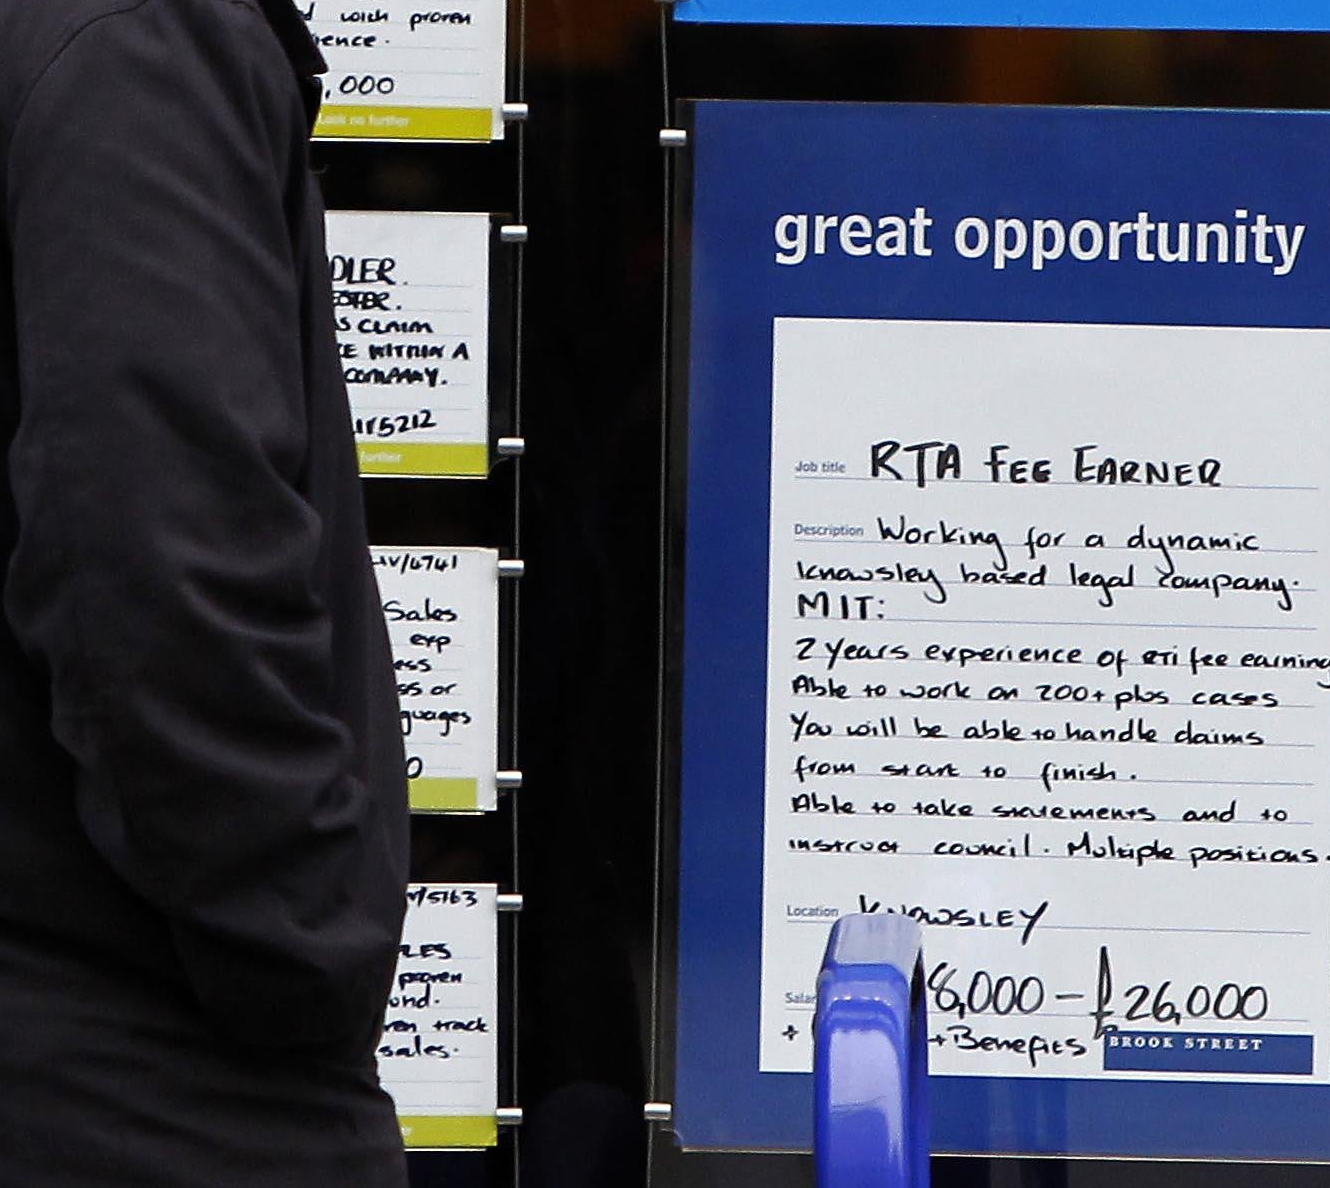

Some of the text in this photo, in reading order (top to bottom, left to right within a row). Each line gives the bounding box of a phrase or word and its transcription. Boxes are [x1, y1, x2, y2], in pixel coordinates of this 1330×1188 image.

[775, 208, 1305, 275] great opportunity
[795, 460, 845, 478] Job title
[872, 441, 960, 488] RTA
[1074, 446, 1220, 487] EARNER
[795, 524, 863, 542] Description
[877, 516, 1259, 574] Working for a dynamic
[961, 560, 1046, 585] based
[1070, 563, 1133, 607] legal
[786, 904, 840, 921] Location
[1110, 1036, 1262, 1050] BROOK STREET
